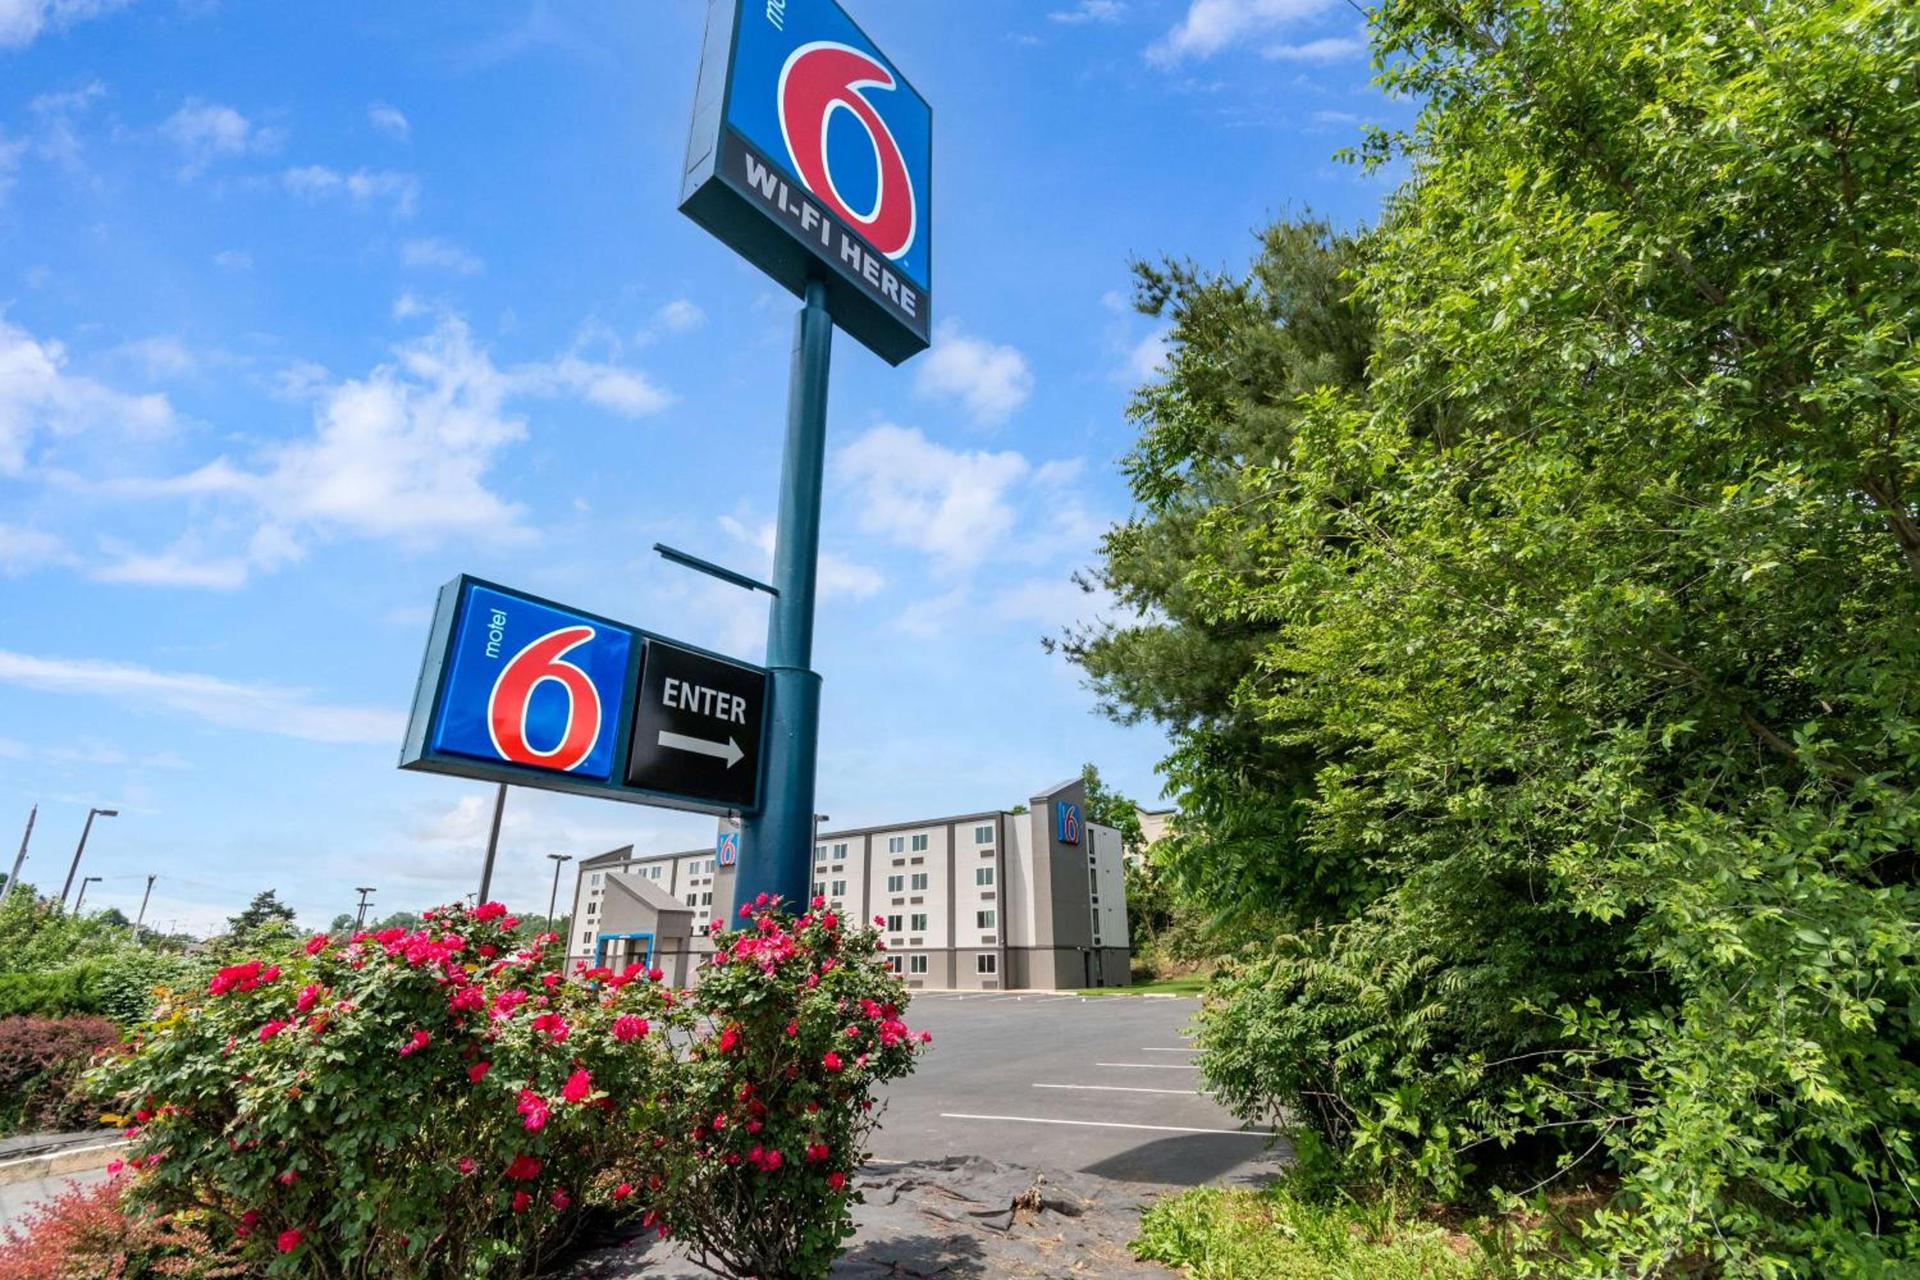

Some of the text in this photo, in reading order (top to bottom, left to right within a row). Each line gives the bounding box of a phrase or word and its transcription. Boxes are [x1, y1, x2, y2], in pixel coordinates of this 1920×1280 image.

[777, 40, 917, 261] 6
[746, 153, 916, 317] WI-FI HERE
[485, 608, 508, 659] motel
[487, 625, 602, 771] 6
[662, 677, 746, 725] ENTER
[720, 832, 737, 866] 6
